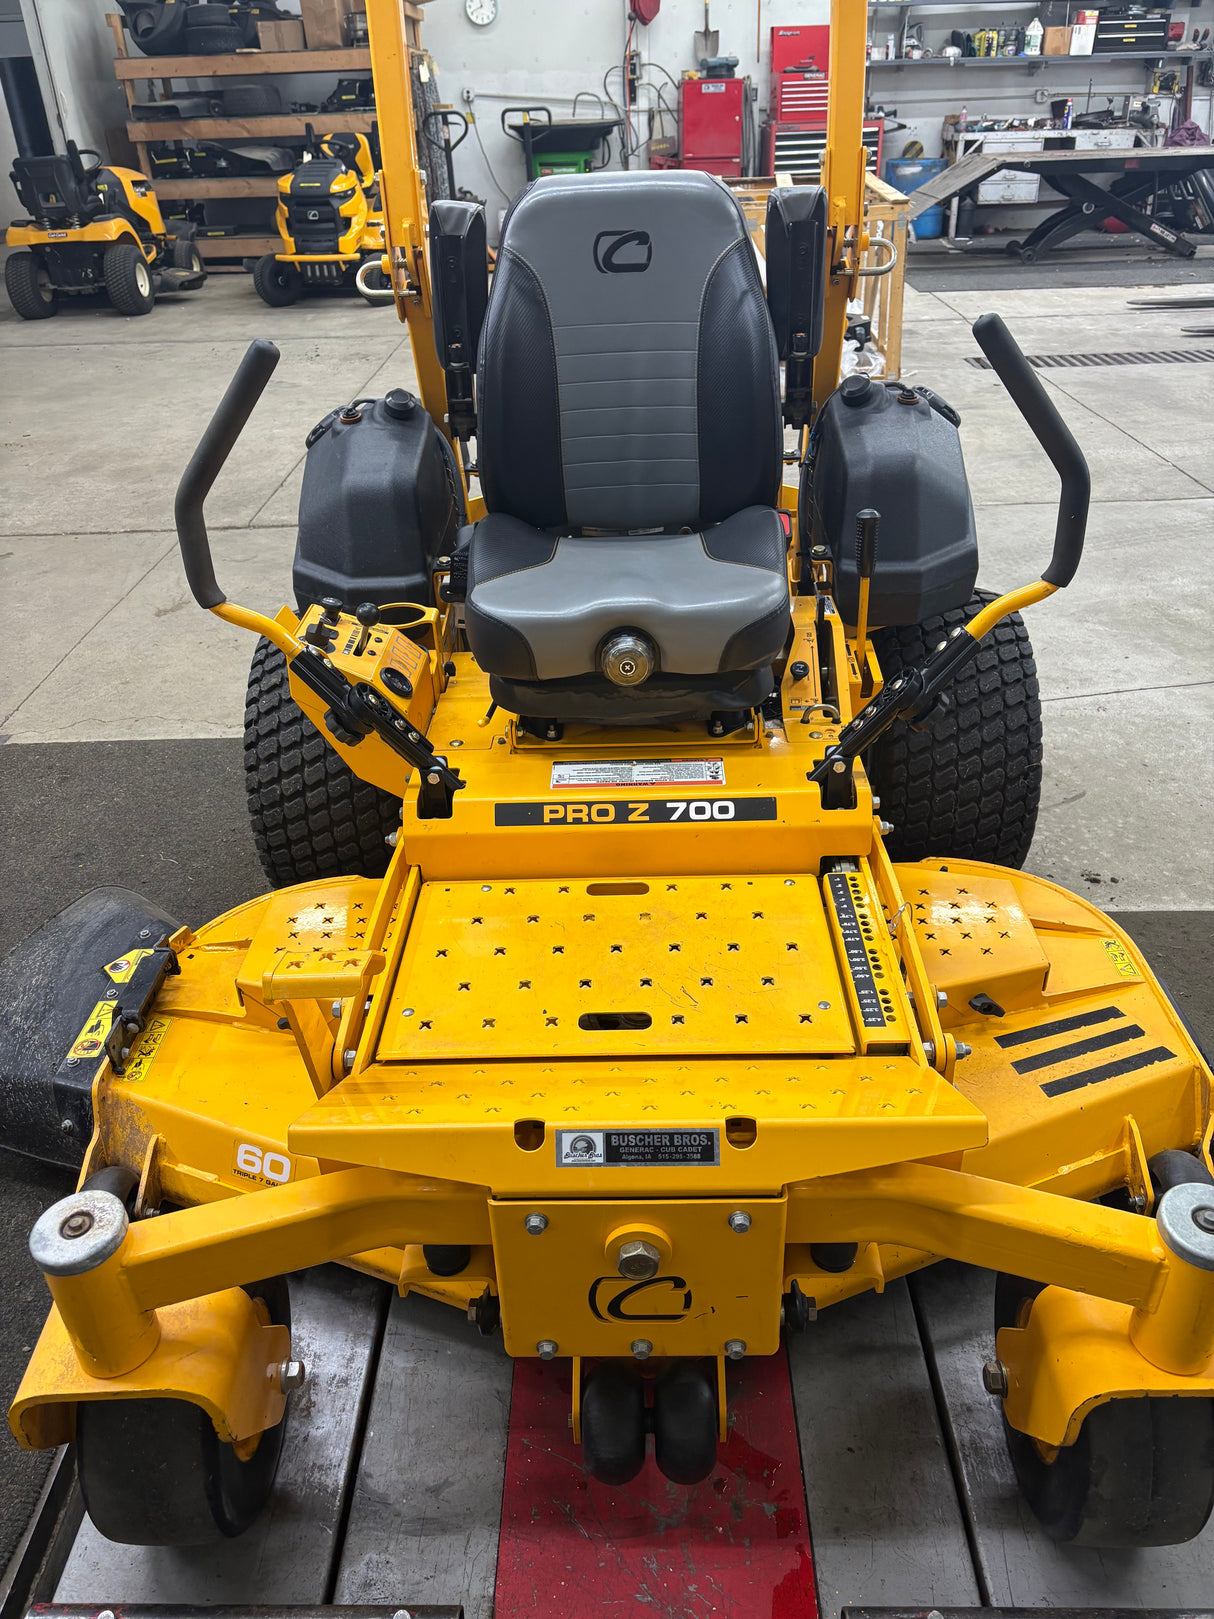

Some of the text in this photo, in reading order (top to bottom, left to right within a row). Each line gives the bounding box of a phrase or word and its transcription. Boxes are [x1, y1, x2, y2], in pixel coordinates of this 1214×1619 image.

[543, 800, 736, 824] PRO Z 700
[611, 1134, 711, 1146] BUSCHER BROS.
[237, 1144, 291, 1182] 60
[232, 1168, 257, 1181] TRIPLE
